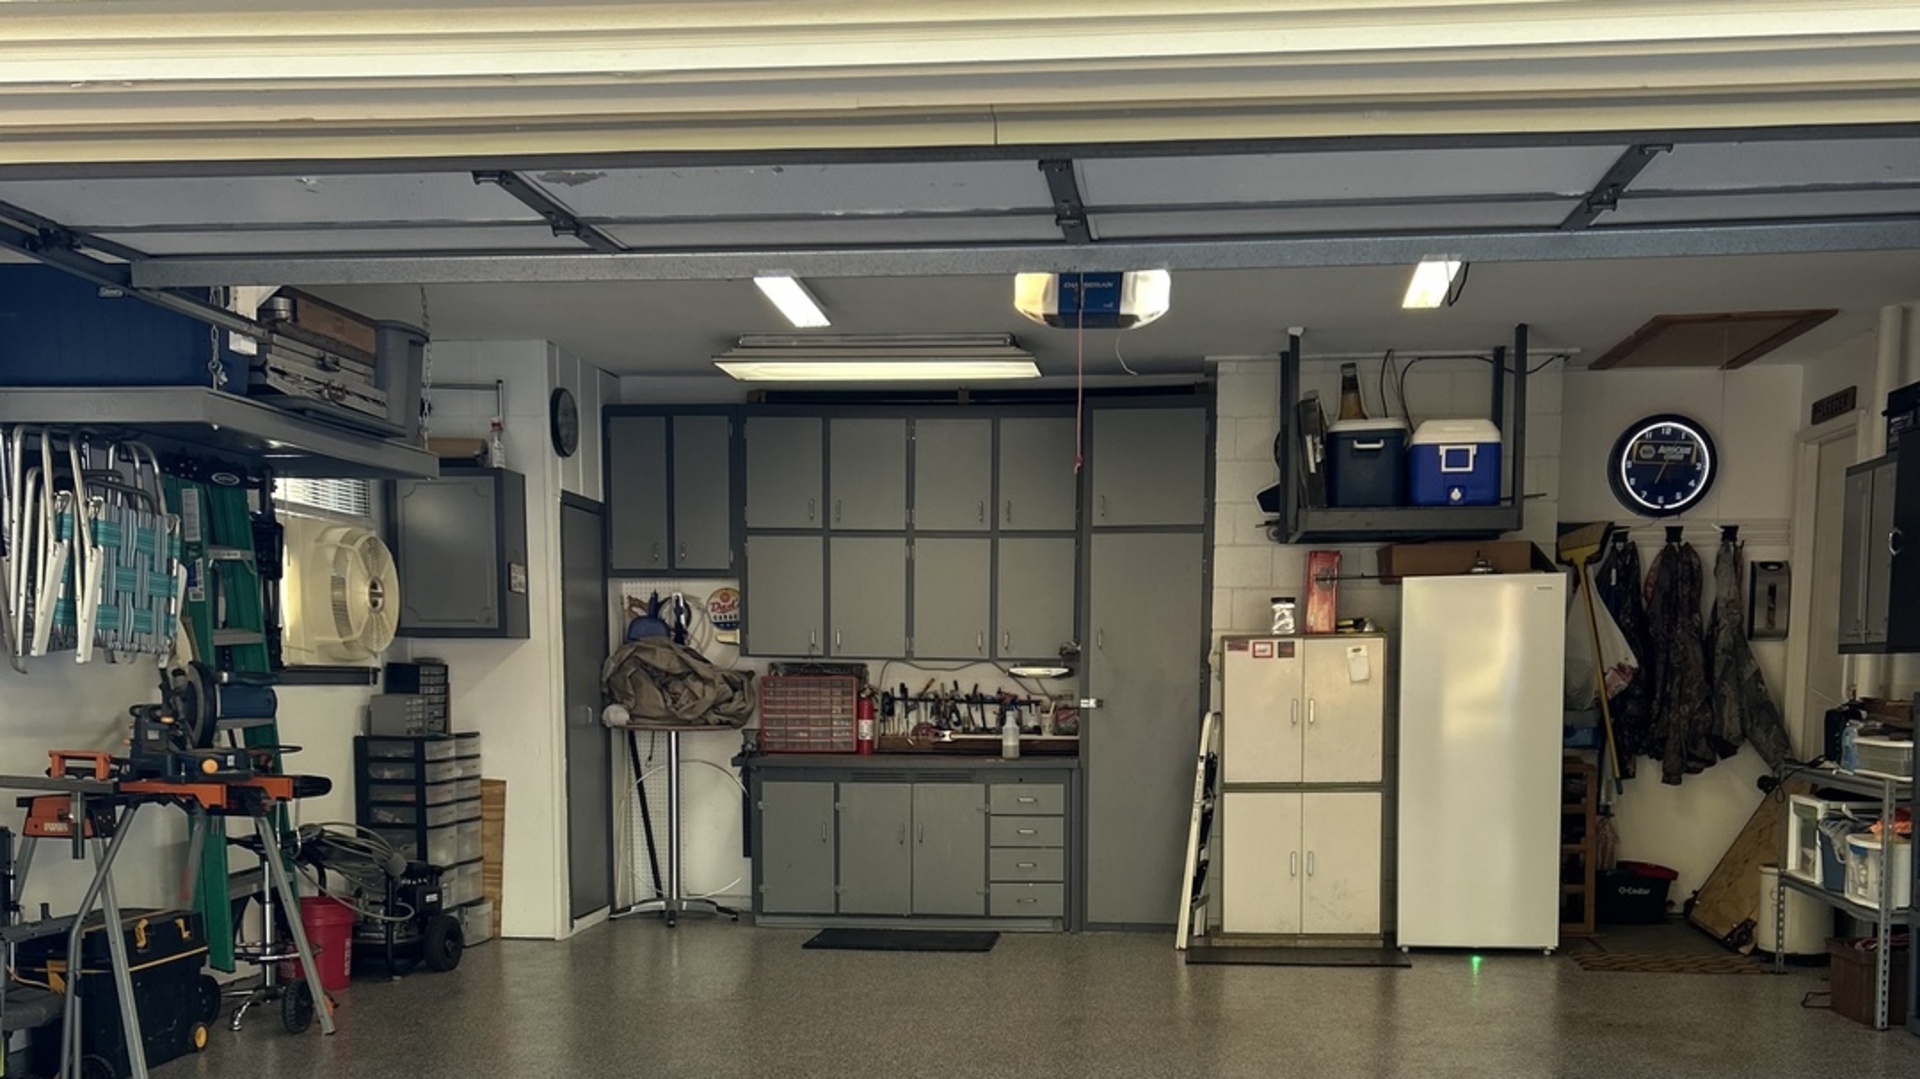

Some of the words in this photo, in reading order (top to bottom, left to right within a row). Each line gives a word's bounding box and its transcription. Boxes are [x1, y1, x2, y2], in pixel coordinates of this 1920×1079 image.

[1063, 281, 1114, 289] CHABERLAIN
[1688, 479, 1695, 487] 4
[1641, 490, 1647, 499] 7
